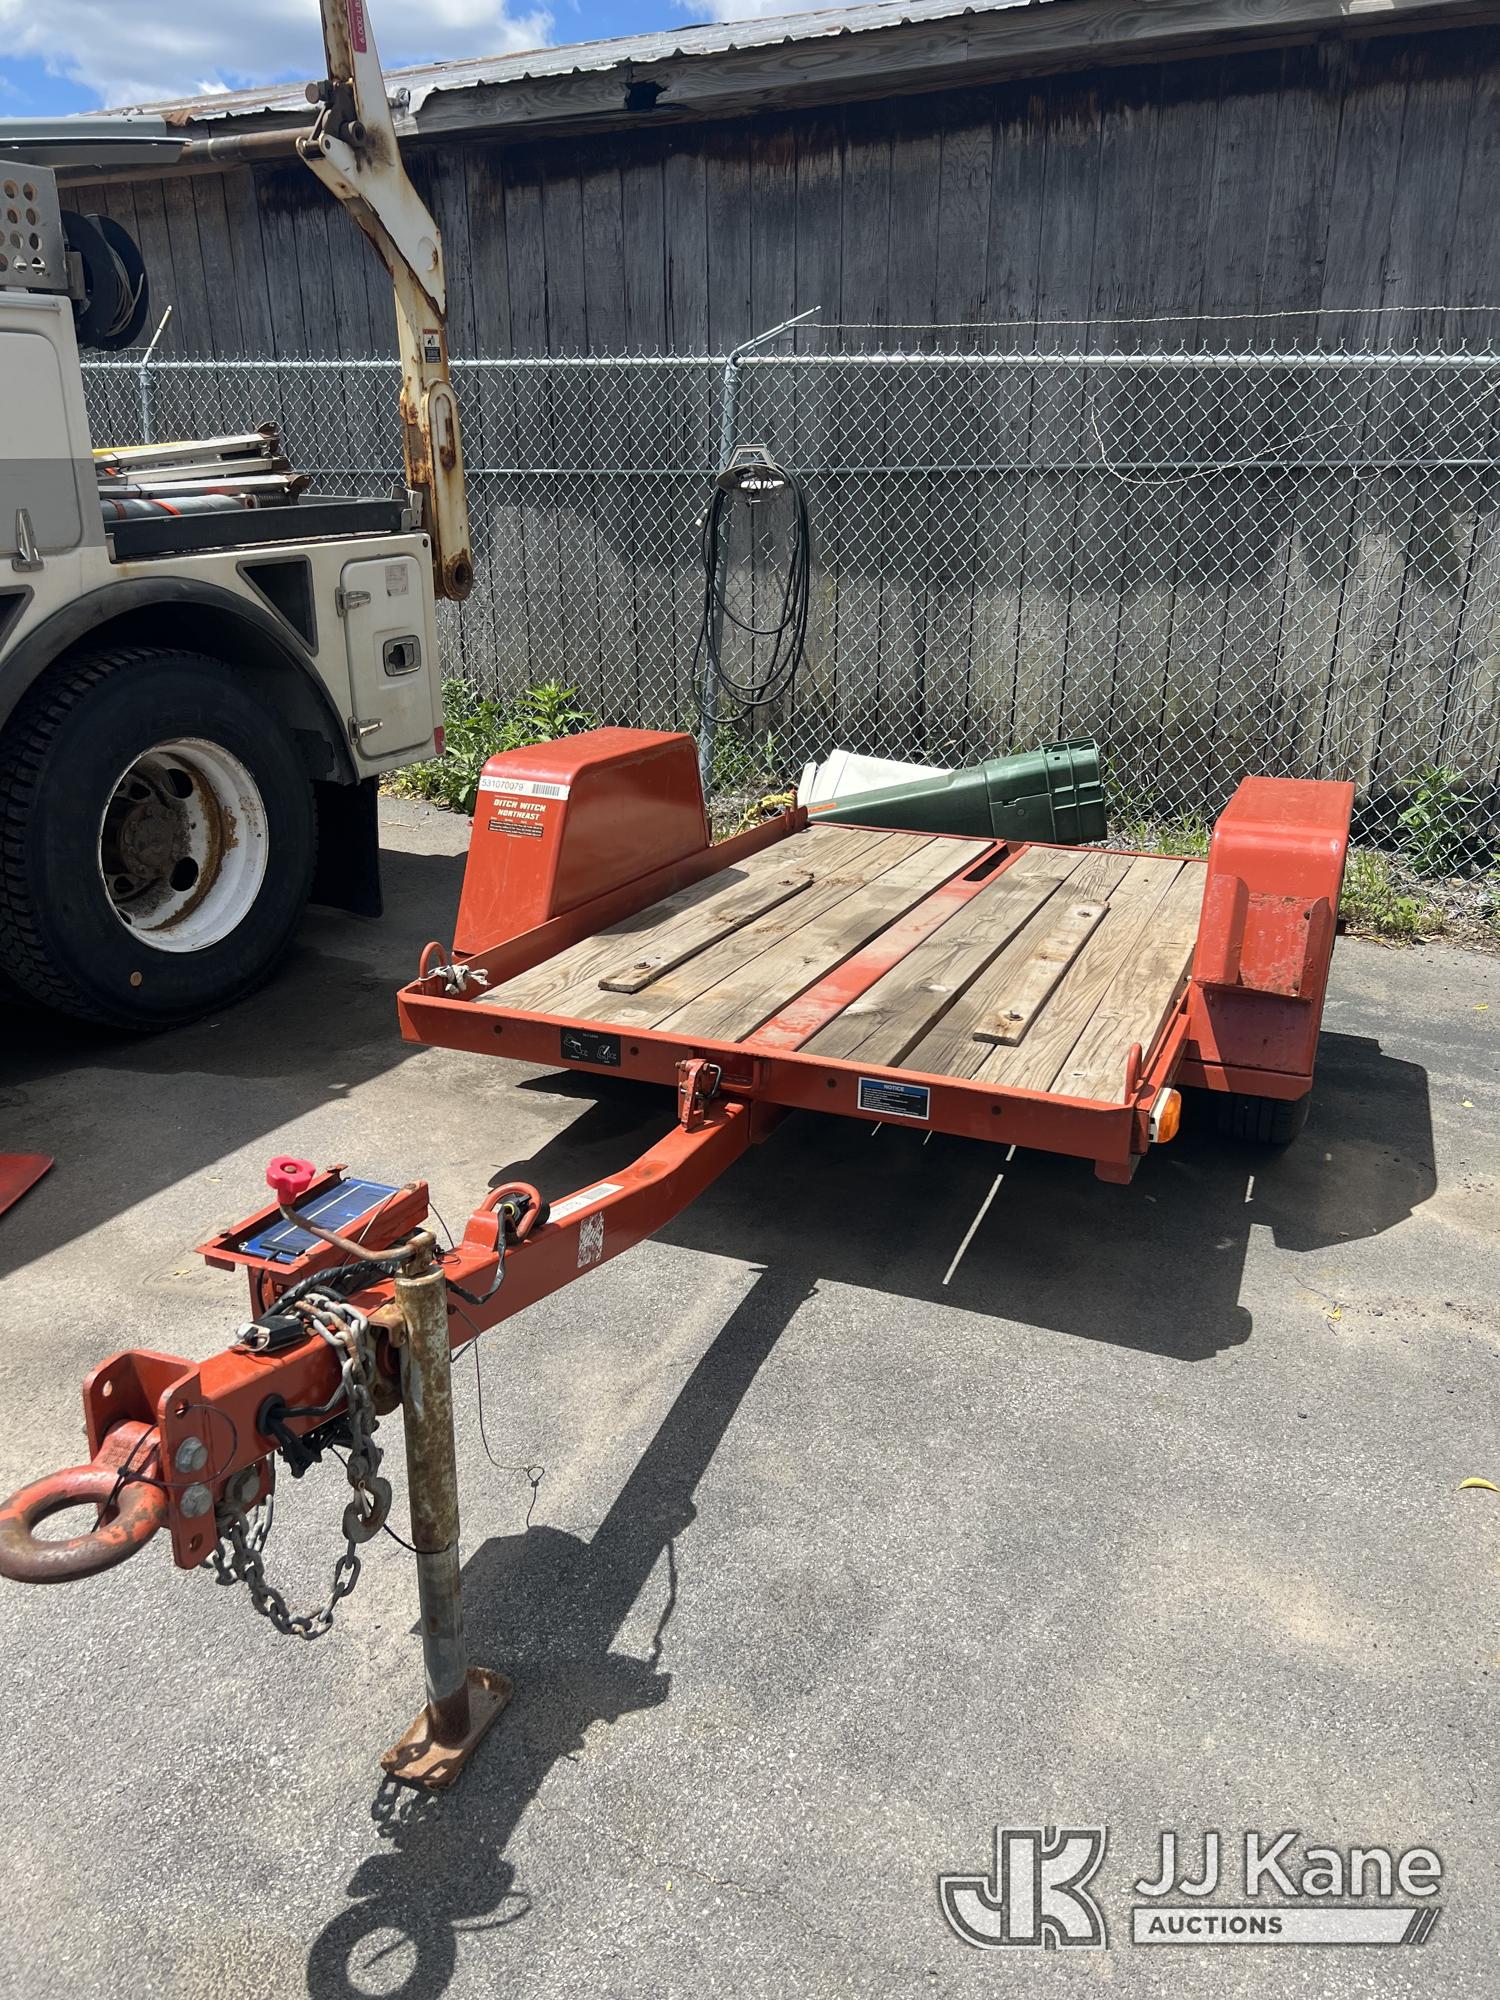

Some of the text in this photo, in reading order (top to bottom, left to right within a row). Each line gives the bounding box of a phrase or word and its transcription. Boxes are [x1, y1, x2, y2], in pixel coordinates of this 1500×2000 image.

[493, 798, 547, 812] DITCH WITCH
[497, 809, 541, 820] NORTHEAST
[883, 1084, 905, 1092] NOTICE
